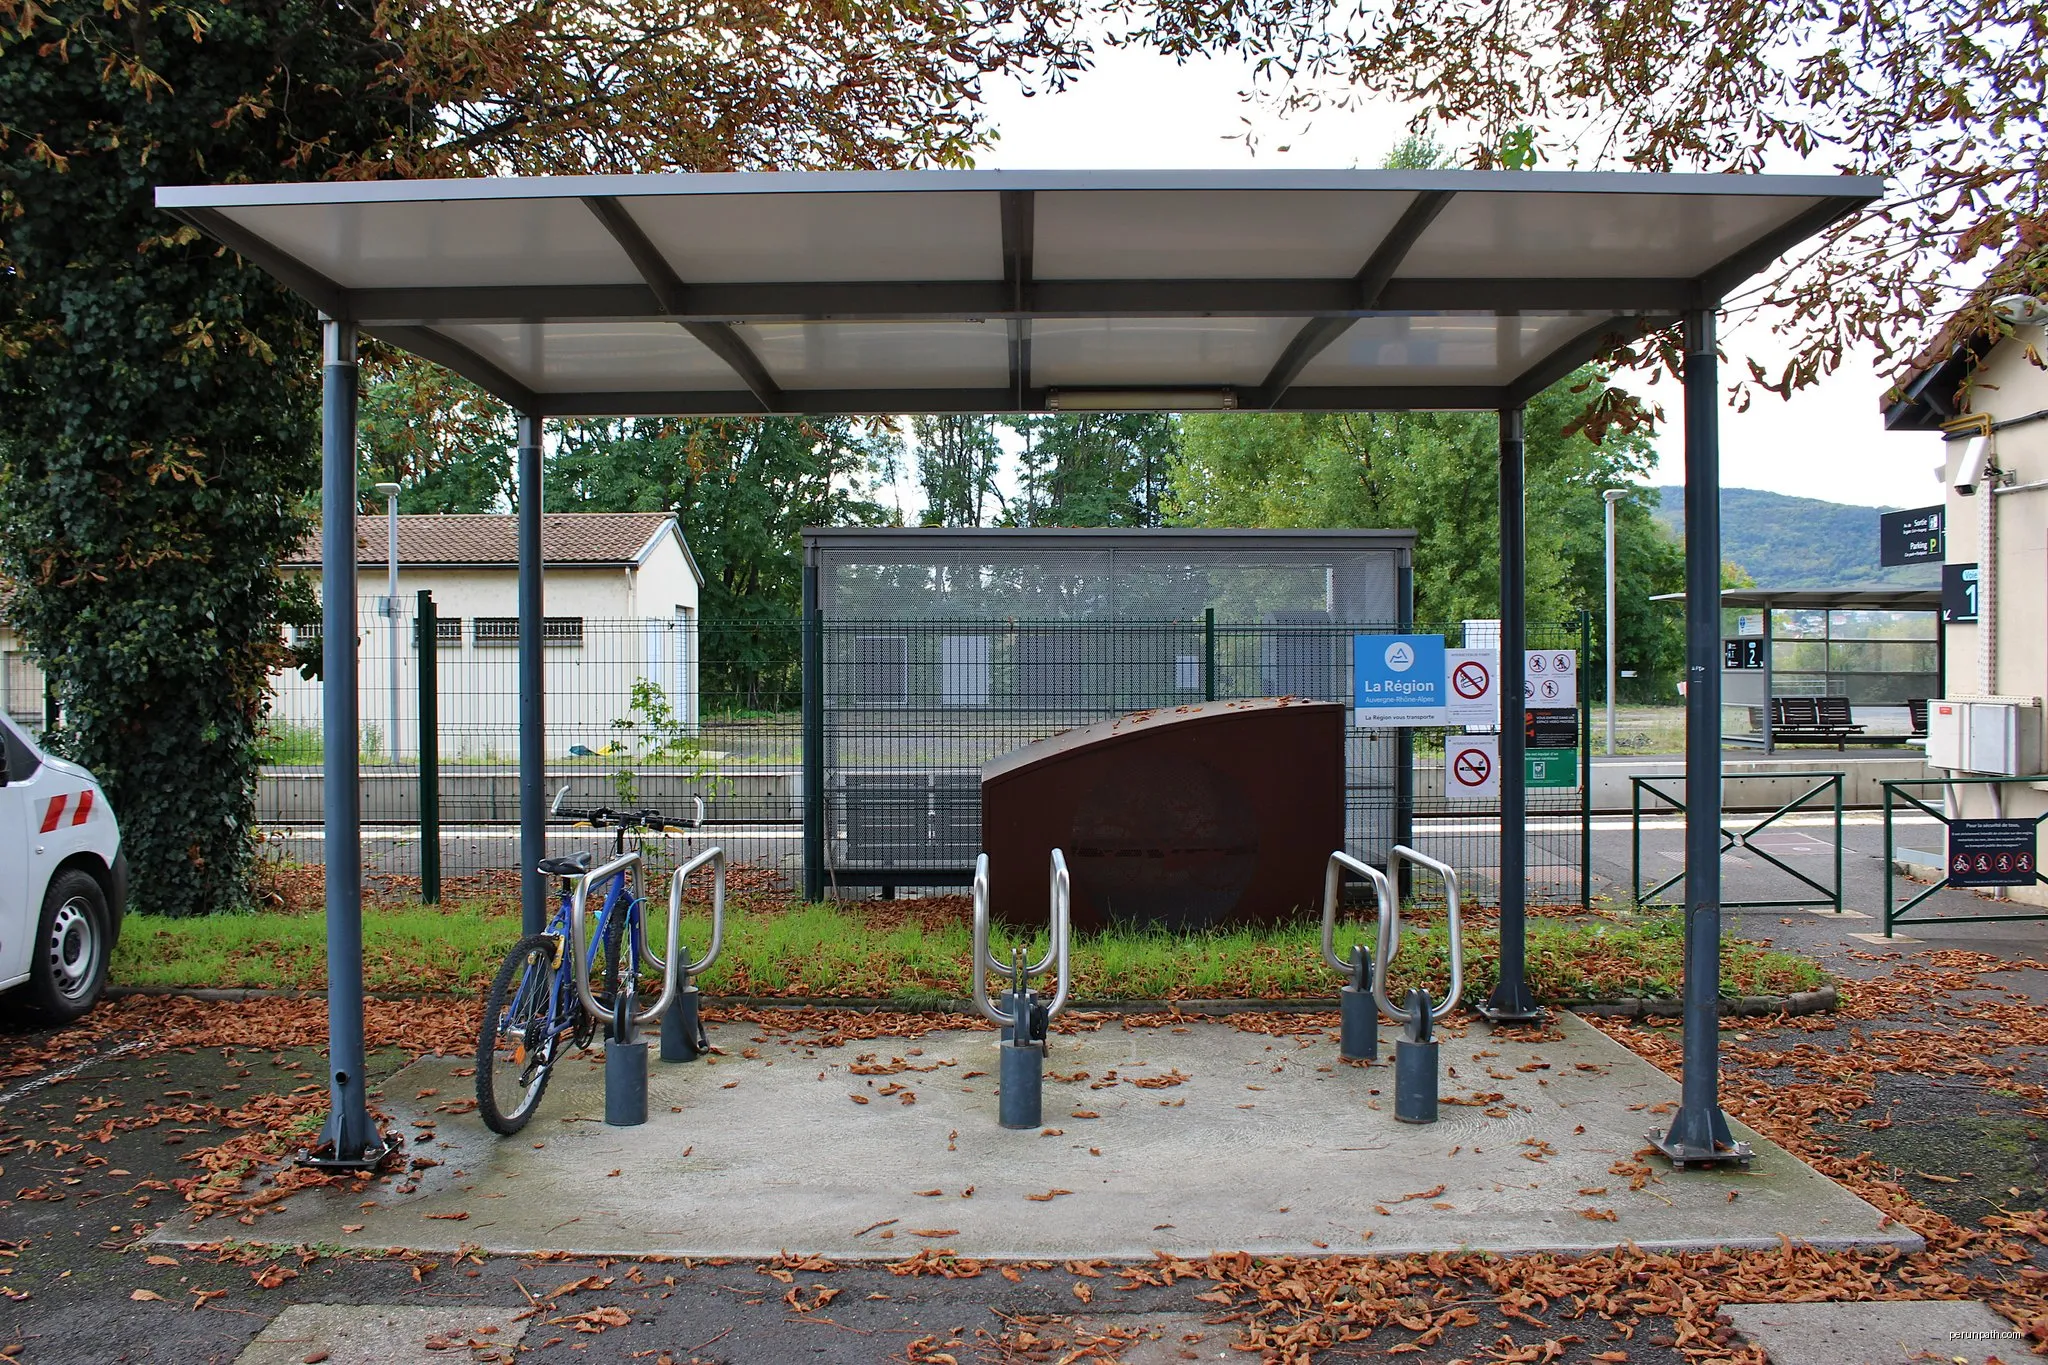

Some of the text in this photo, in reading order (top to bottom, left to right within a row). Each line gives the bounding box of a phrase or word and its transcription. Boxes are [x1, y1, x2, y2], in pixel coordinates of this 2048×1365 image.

[1910, 541, 1928, 551] Parking
[1965, 584, 1977, 614] 1
[1749, 649, 1756, 665] 2
[1365, 680, 1434, 694] La Région
[1365, 695, 1435, 704] Auvergne-Rhône-Alpes
